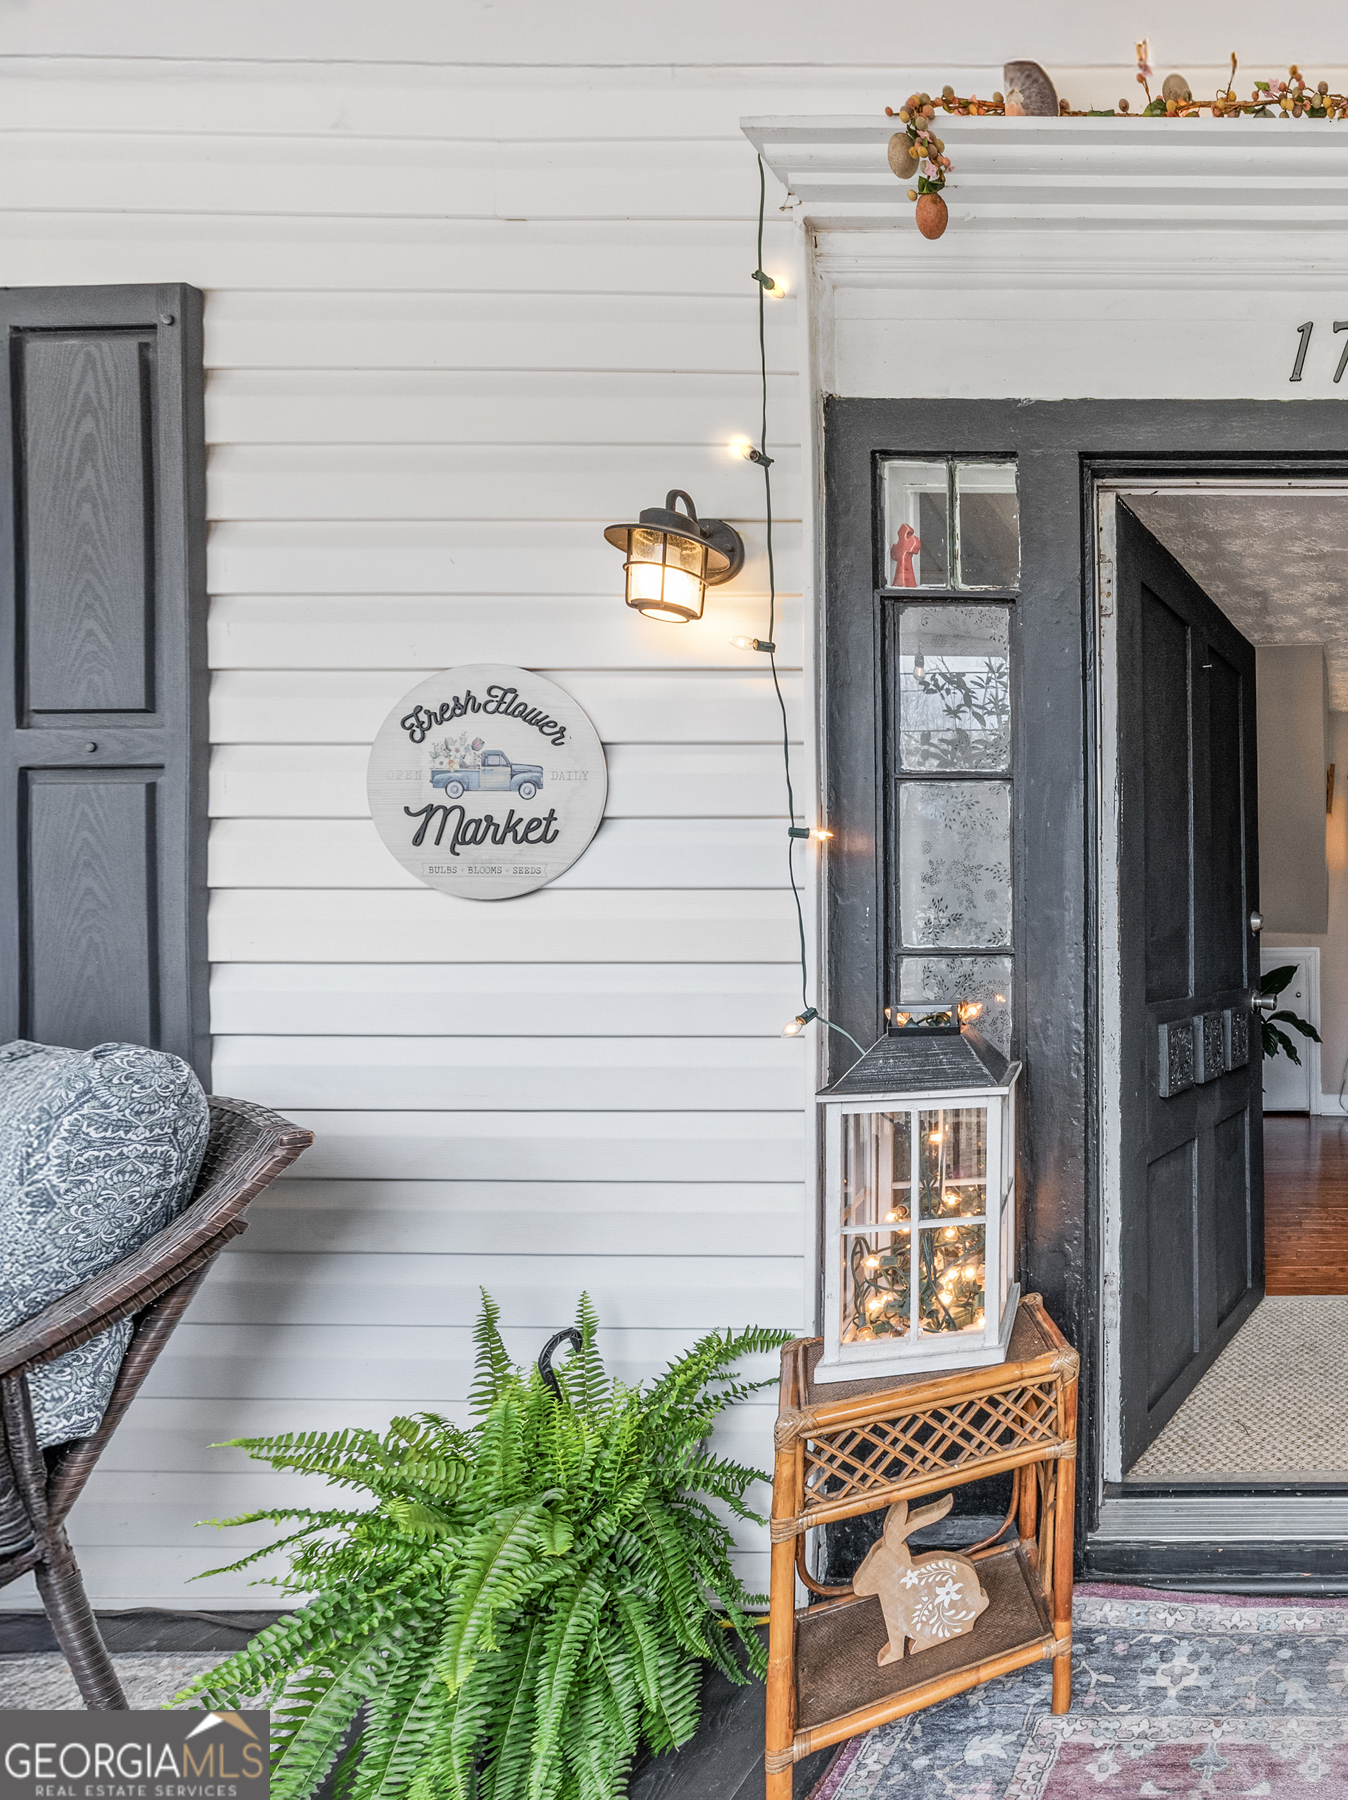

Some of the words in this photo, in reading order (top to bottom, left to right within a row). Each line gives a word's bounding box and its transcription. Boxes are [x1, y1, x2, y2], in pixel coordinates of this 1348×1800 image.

[400, 690, 482, 744] Fresh
[482, 685, 567, 746] Flower
[386, 770, 422, 780] OPEN
[550, 770, 589, 781] DAILY
[403, 803, 560, 857] Market
[428, 865, 458, 874] BULBS
[467, 865, 503, 874] BLOOMS
[512, 865, 542, 875] SEEDS
